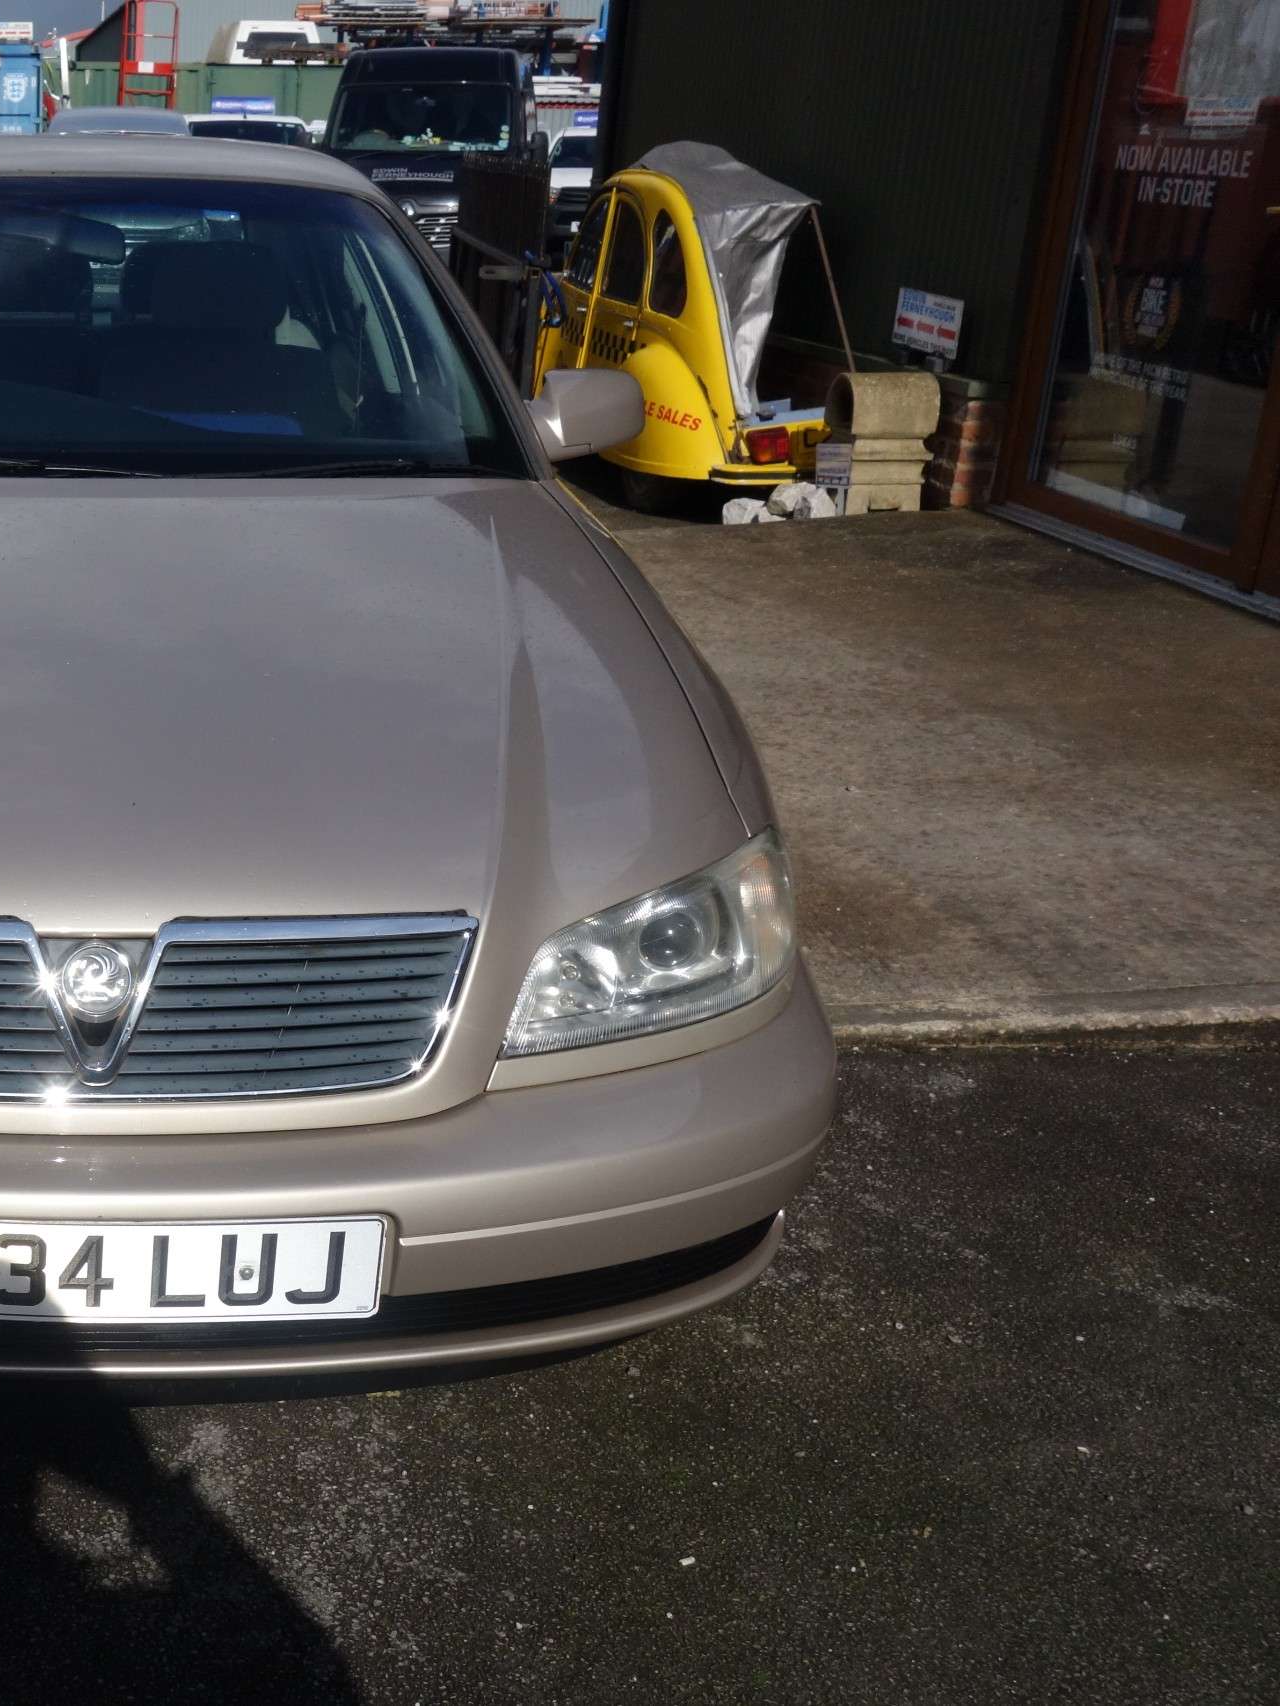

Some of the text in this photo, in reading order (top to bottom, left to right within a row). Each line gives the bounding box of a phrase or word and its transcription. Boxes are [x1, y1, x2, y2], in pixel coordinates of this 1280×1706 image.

[1115, 144, 1253, 178] NOW AVAILABLE
[1137, 176, 1216, 208] IN-STORE
[657, 405, 702, 431] SALES
[150, 1231, 346, 1308] LUJ
